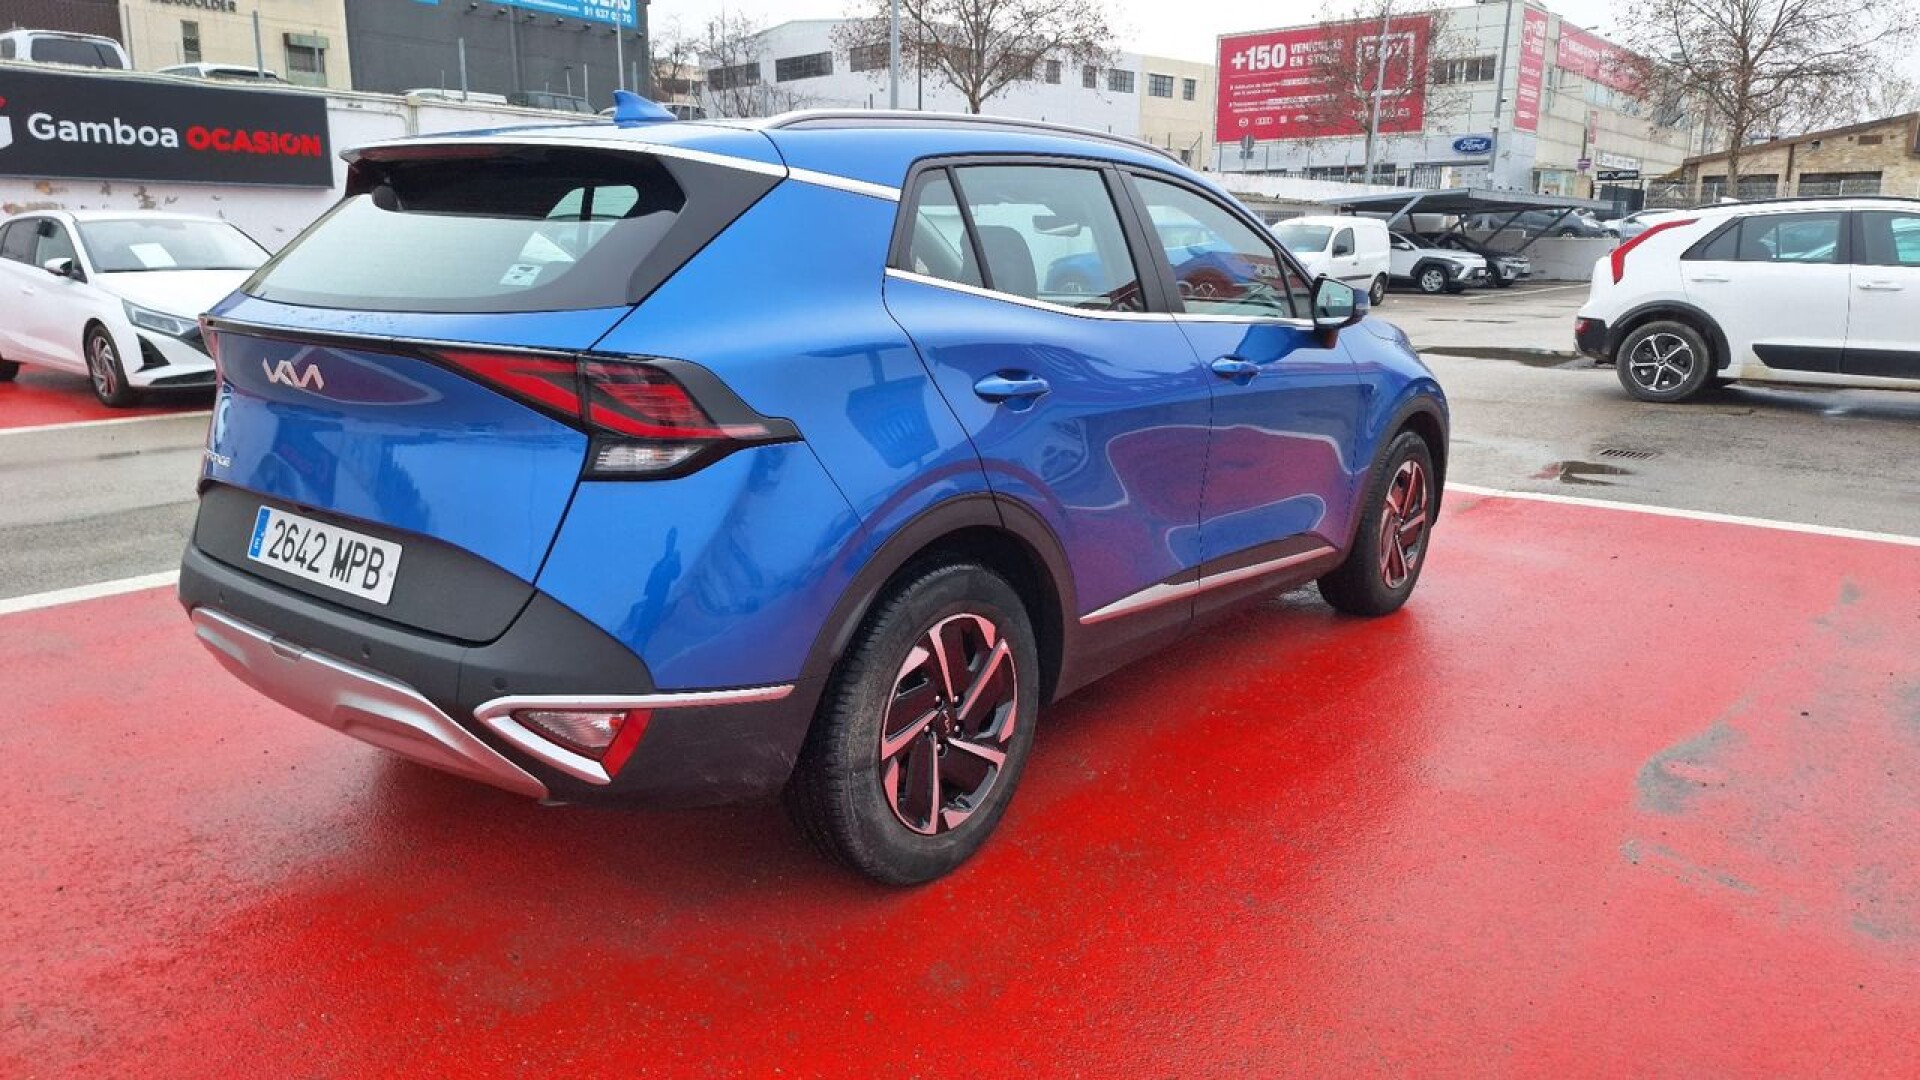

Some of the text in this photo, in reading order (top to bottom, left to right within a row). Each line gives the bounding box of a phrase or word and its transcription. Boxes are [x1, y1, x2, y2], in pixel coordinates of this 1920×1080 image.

[1231, 43, 1287, 71] +150
[27, 112, 179, 148] Gamboa
[1460, 138, 1488, 151] Ford
[262, 357, 324, 390] KIA
[267, 518, 385, 591] 2642 MPB
